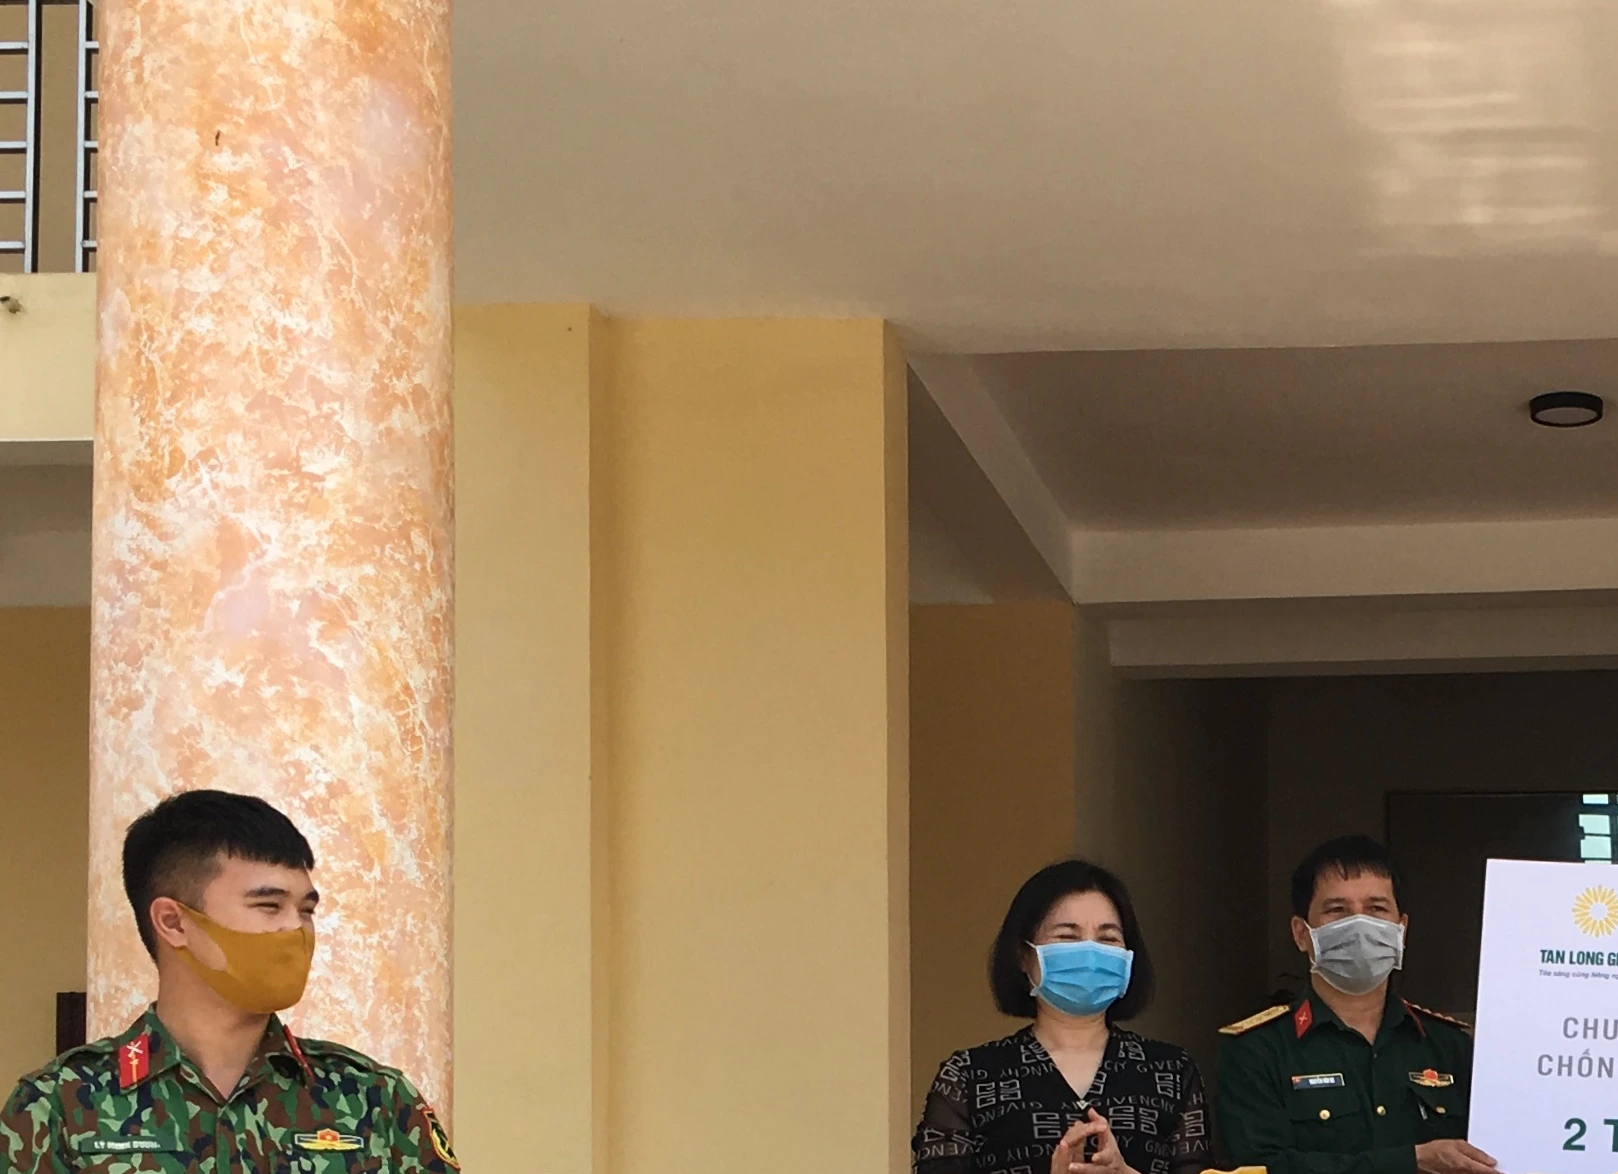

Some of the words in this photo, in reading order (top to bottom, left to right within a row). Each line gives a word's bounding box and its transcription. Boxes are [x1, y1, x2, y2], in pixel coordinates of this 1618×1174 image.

[1540, 949, 1565, 964] TAN
[1569, 950, 1604, 966] LONG
[1562, 1117, 1587, 1152] 2
